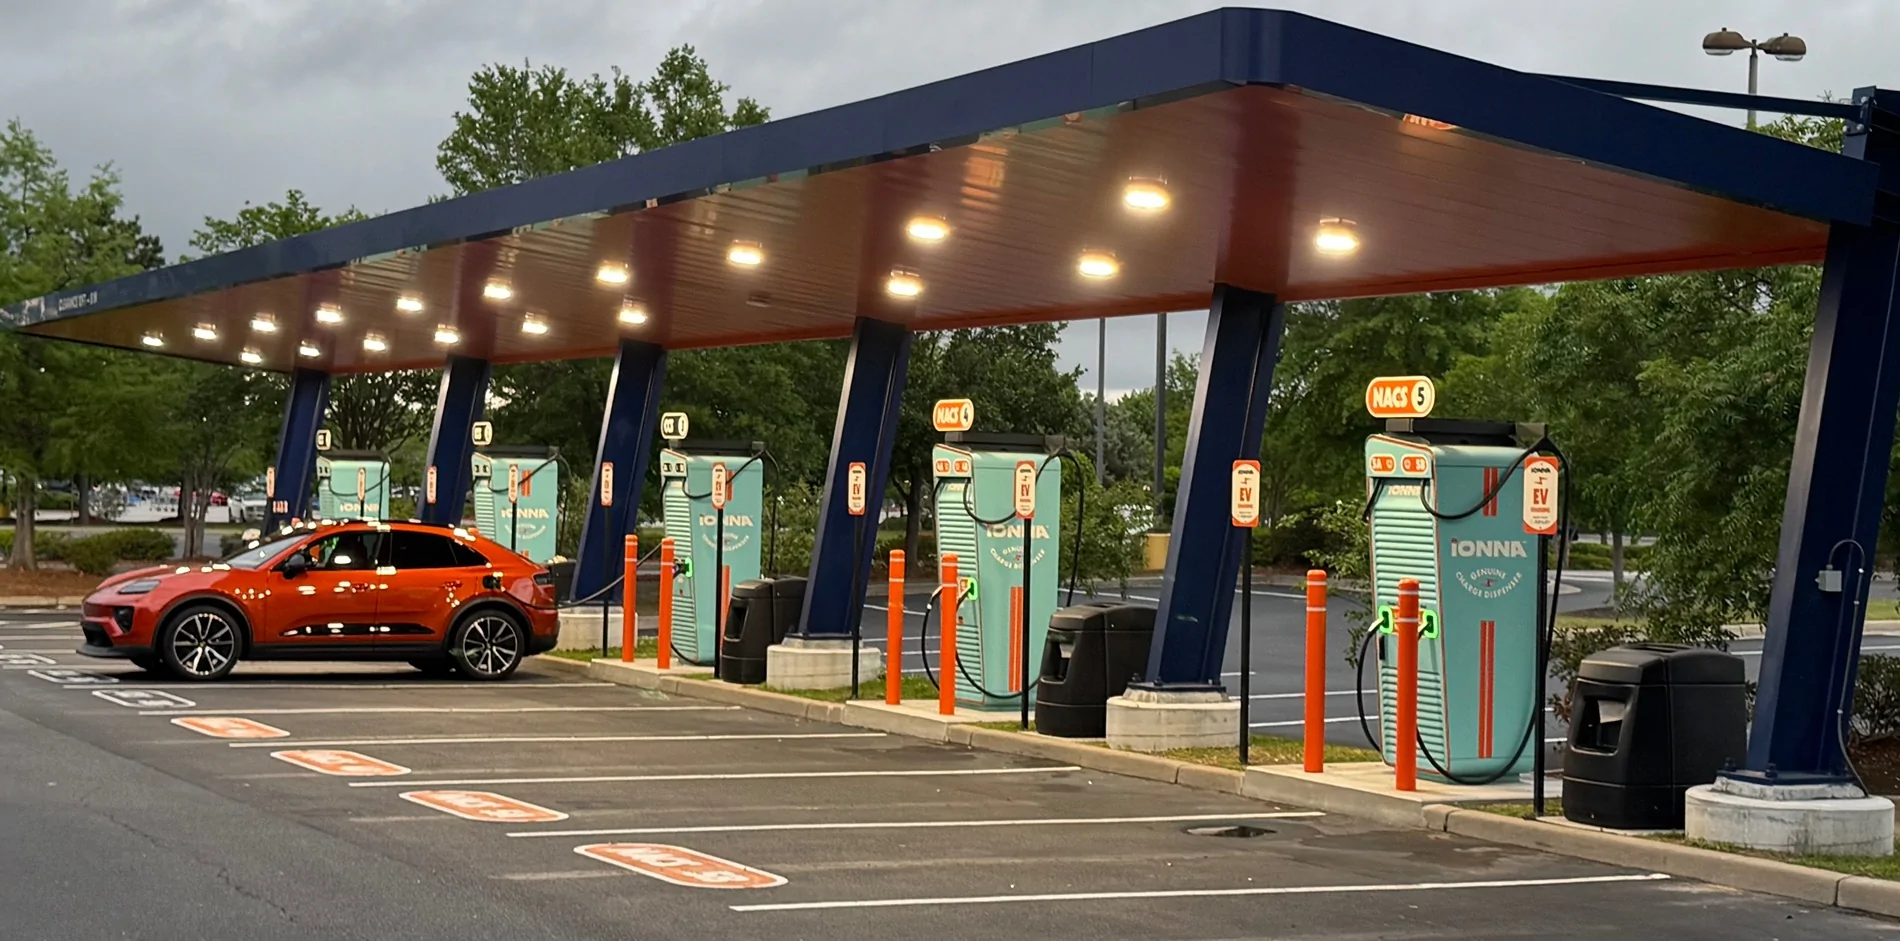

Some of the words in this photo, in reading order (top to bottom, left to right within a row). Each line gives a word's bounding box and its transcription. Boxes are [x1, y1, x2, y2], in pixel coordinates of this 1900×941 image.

[1373, 385, 1408, 408] NACS
[1417, 387, 1425, 406] 5
[937, 406, 959, 424] NACS
[1240, 488, 1252, 502] EV
[1533, 488, 1549, 505] EV
